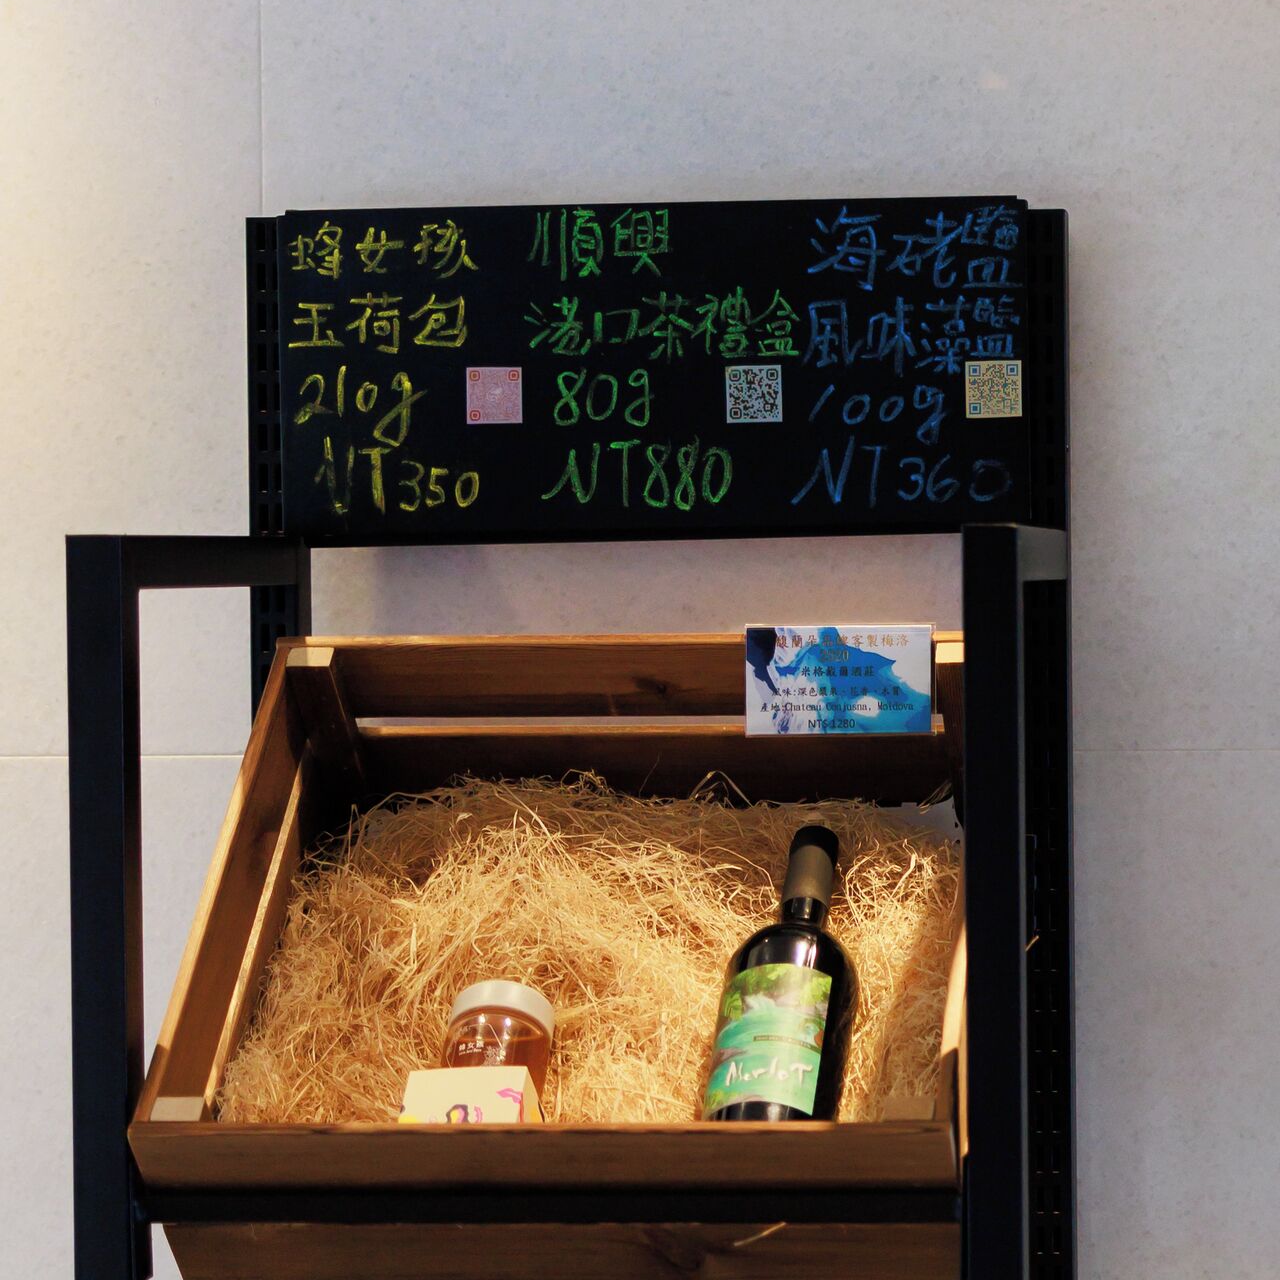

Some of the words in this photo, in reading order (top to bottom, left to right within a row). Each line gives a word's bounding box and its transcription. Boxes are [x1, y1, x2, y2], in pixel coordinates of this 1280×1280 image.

[288, 219, 479, 280] 蜂女孩
[528, 208, 672, 281] 順興
[288, 292, 468, 353] 玉荷包
[294, 365, 428, 447] 210g
[553, 368, 655, 427] 80g
[808, 384, 945, 445] 100g
[541, 434, 733, 511] NT880
[790, 435, 1014, 508] NT360
